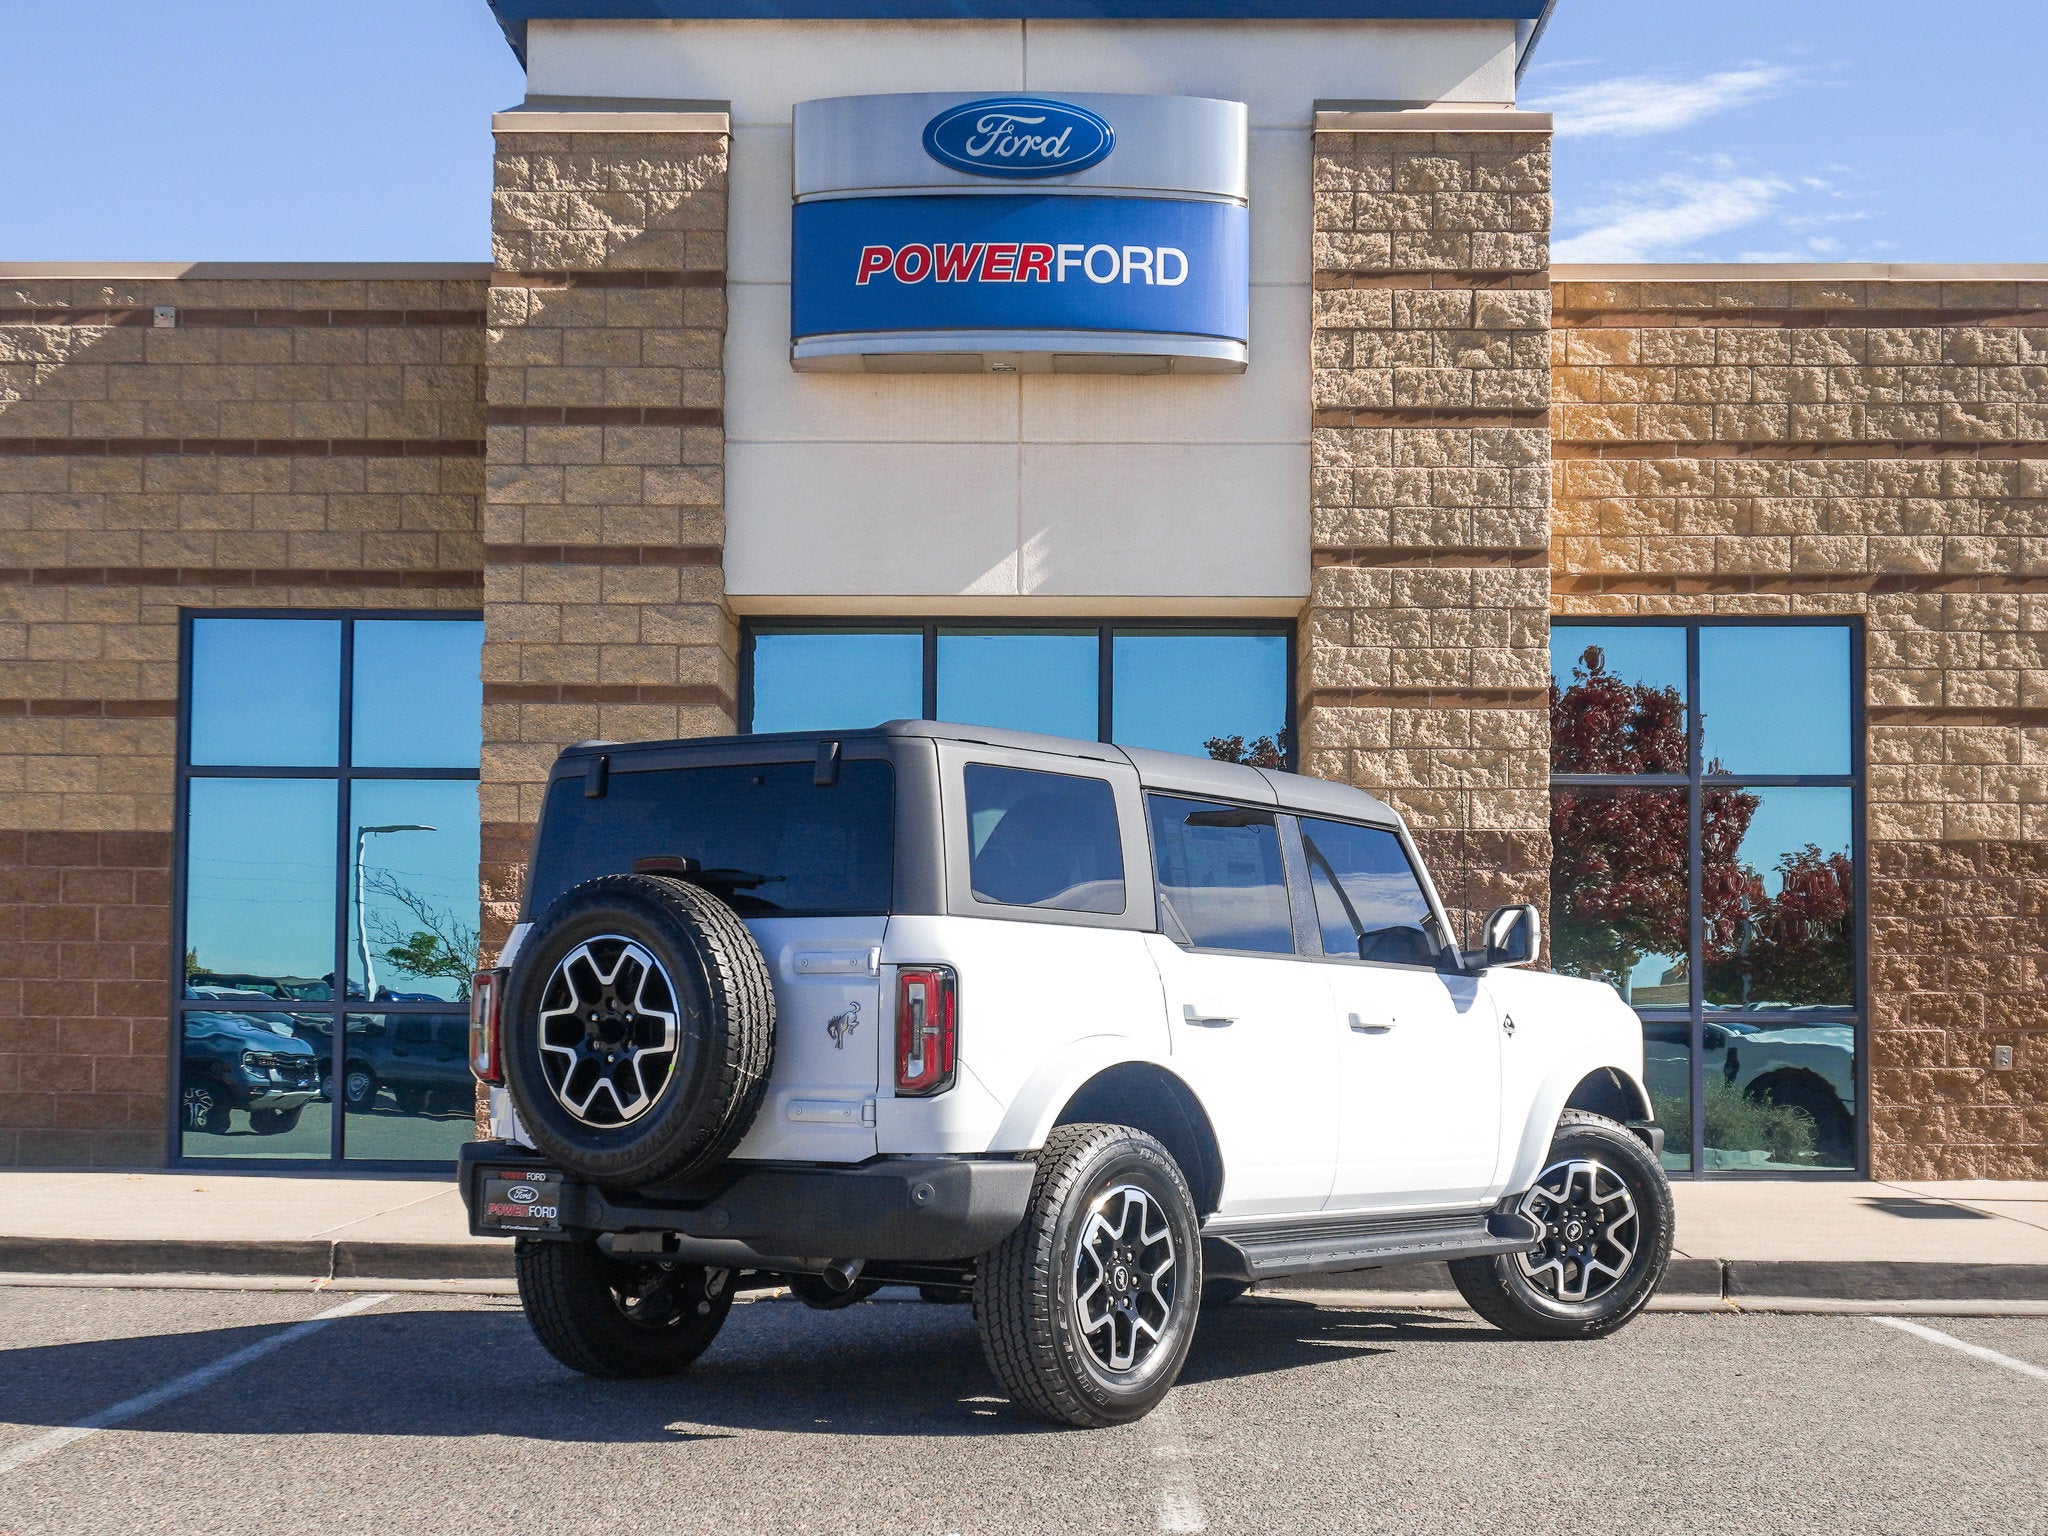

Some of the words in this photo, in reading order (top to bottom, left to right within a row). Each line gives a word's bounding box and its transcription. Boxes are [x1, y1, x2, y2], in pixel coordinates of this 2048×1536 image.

[965, 113, 1073, 159] Ford
[856, 242, 1189, 287] POWERFORD
[513, 1188, 533, 1200] Ford
[487, 1203, 557, 1219] POWERFORD
